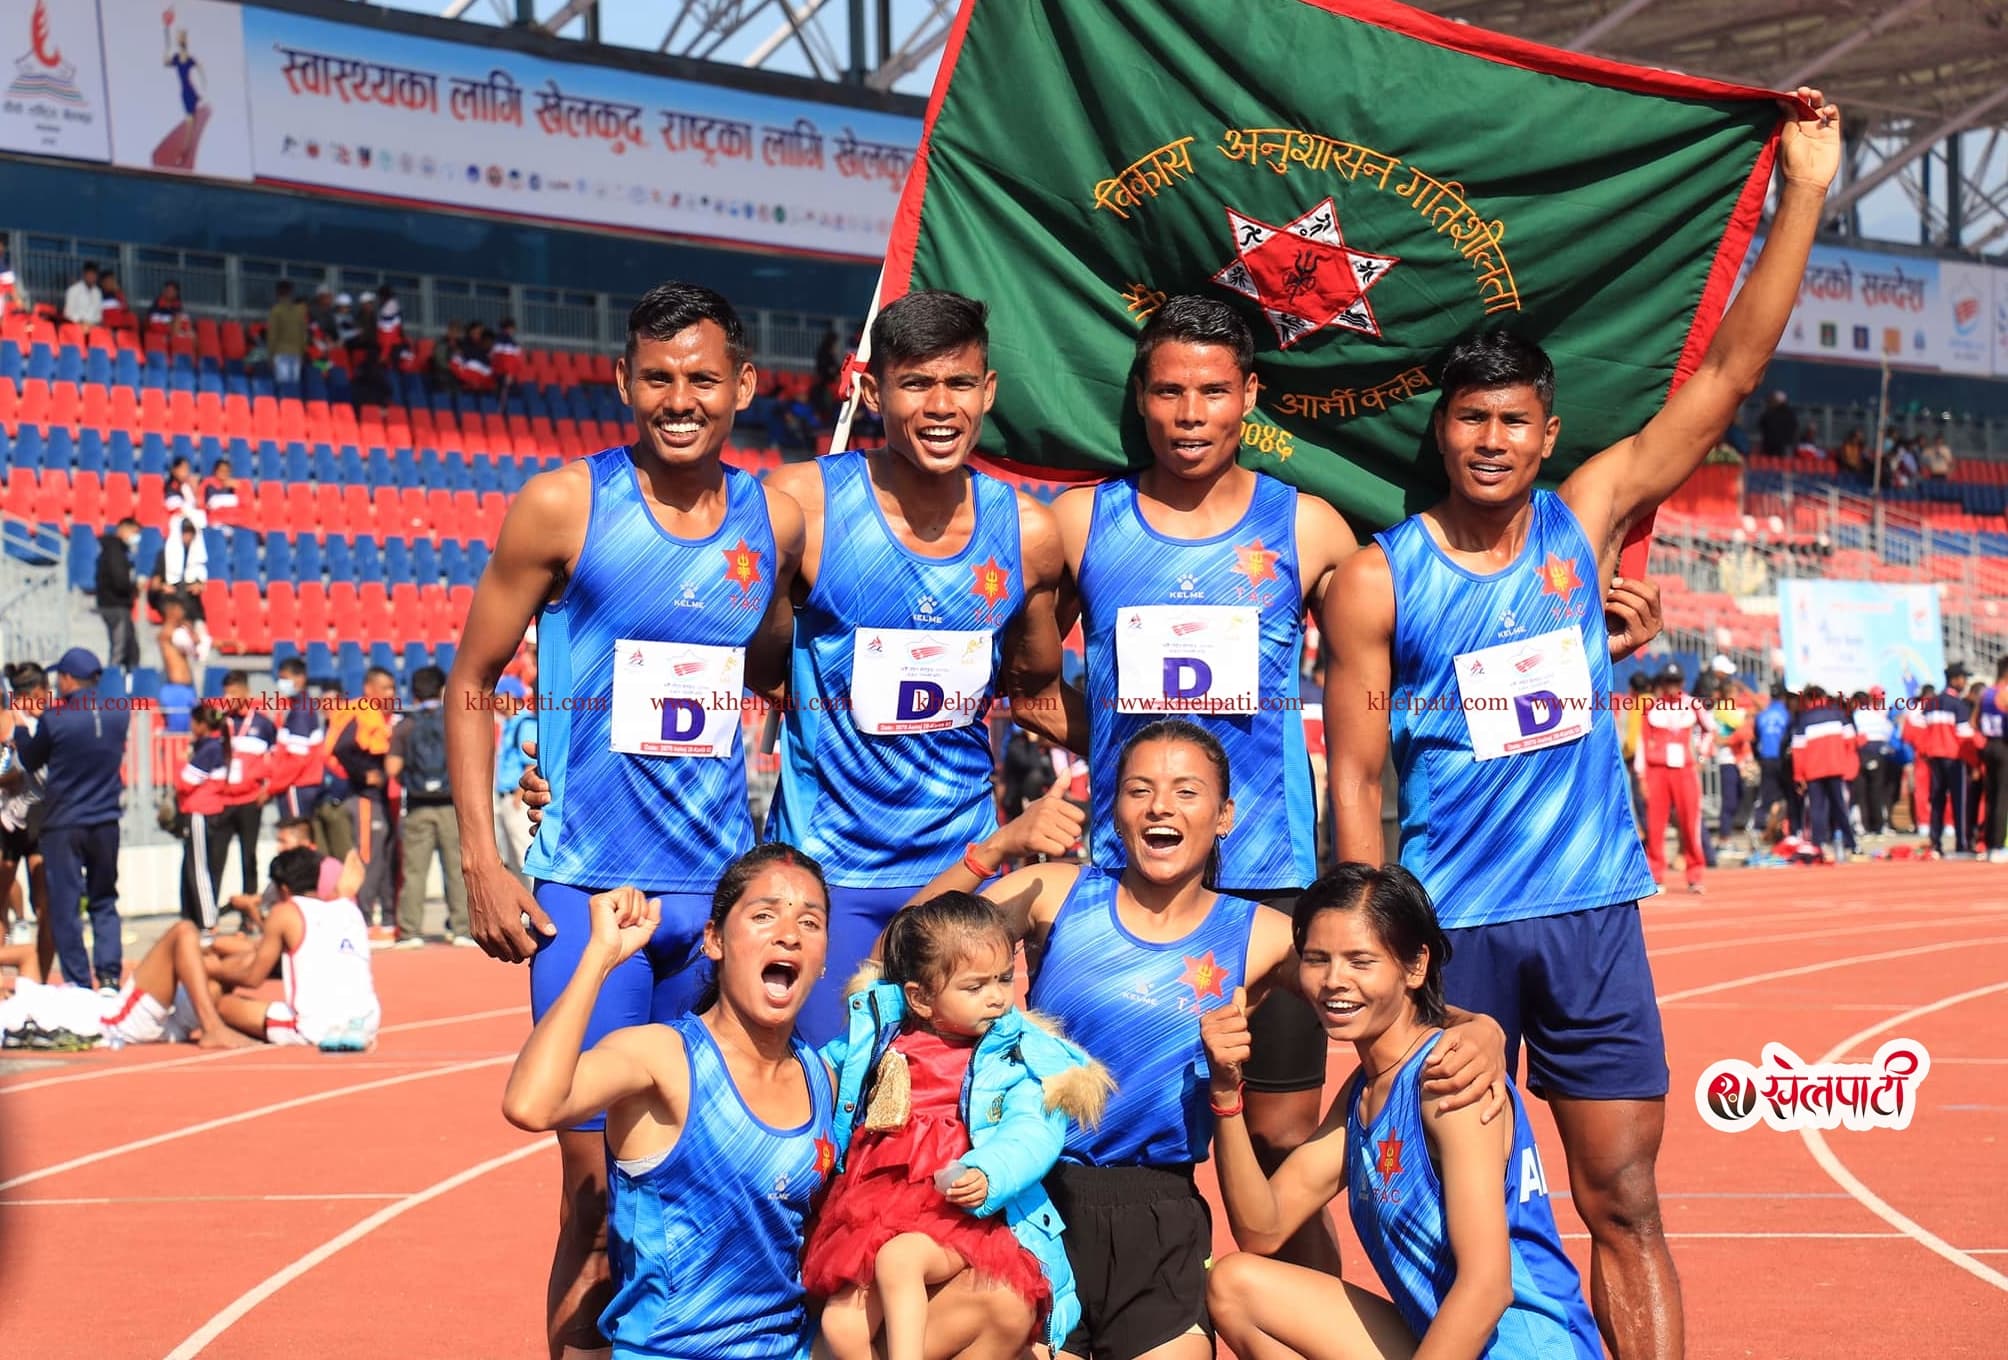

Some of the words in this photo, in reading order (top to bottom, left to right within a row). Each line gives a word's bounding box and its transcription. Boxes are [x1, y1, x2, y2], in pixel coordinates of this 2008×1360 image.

[449, 70, 523, 127] लागि
[762, 118, 825, 171] लागि
[832, 126, 918, 193] खेलकु
[1094, 135, 1195, 220] विकास
[1216, 128, 1402, 190] अनुशासन
[1272, 388, 1356, 419] आर्मी
[673, 599, 705, 609] KELME
[1168, 591, 1205, 600] KELME
[1162, 657, 1213, 699] D
[661, 697, 706, 742] D
[896, 680, 945, 721] D
[1513, 689, 1563, 737] D
